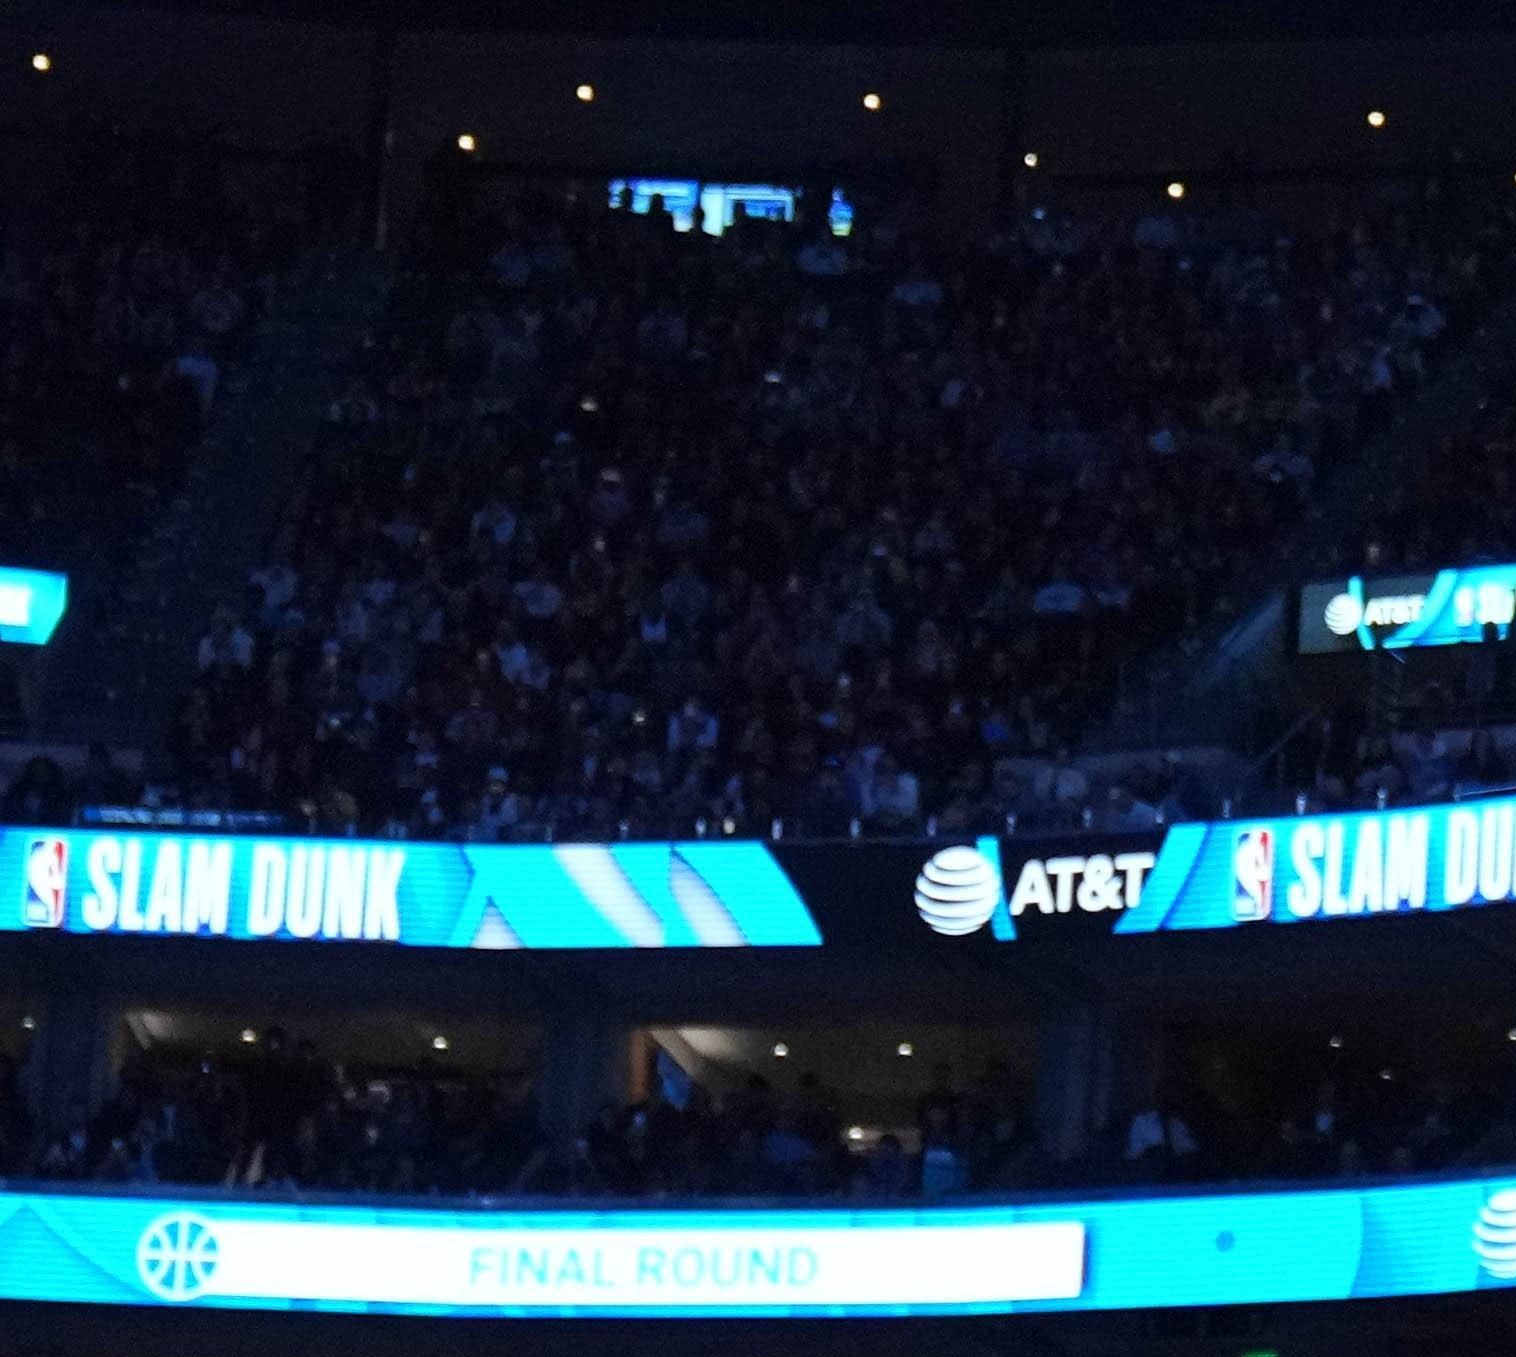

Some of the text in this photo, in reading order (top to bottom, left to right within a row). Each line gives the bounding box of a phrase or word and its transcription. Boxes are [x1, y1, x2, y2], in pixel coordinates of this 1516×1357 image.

[82, 834, 405, 941] SLAM DUNK
[1009, 851, 1155, 917] AT&T
[1286, 812, 1427, 919] SLAM
[468, 1244, 820, 1291] FINAL ROUND
